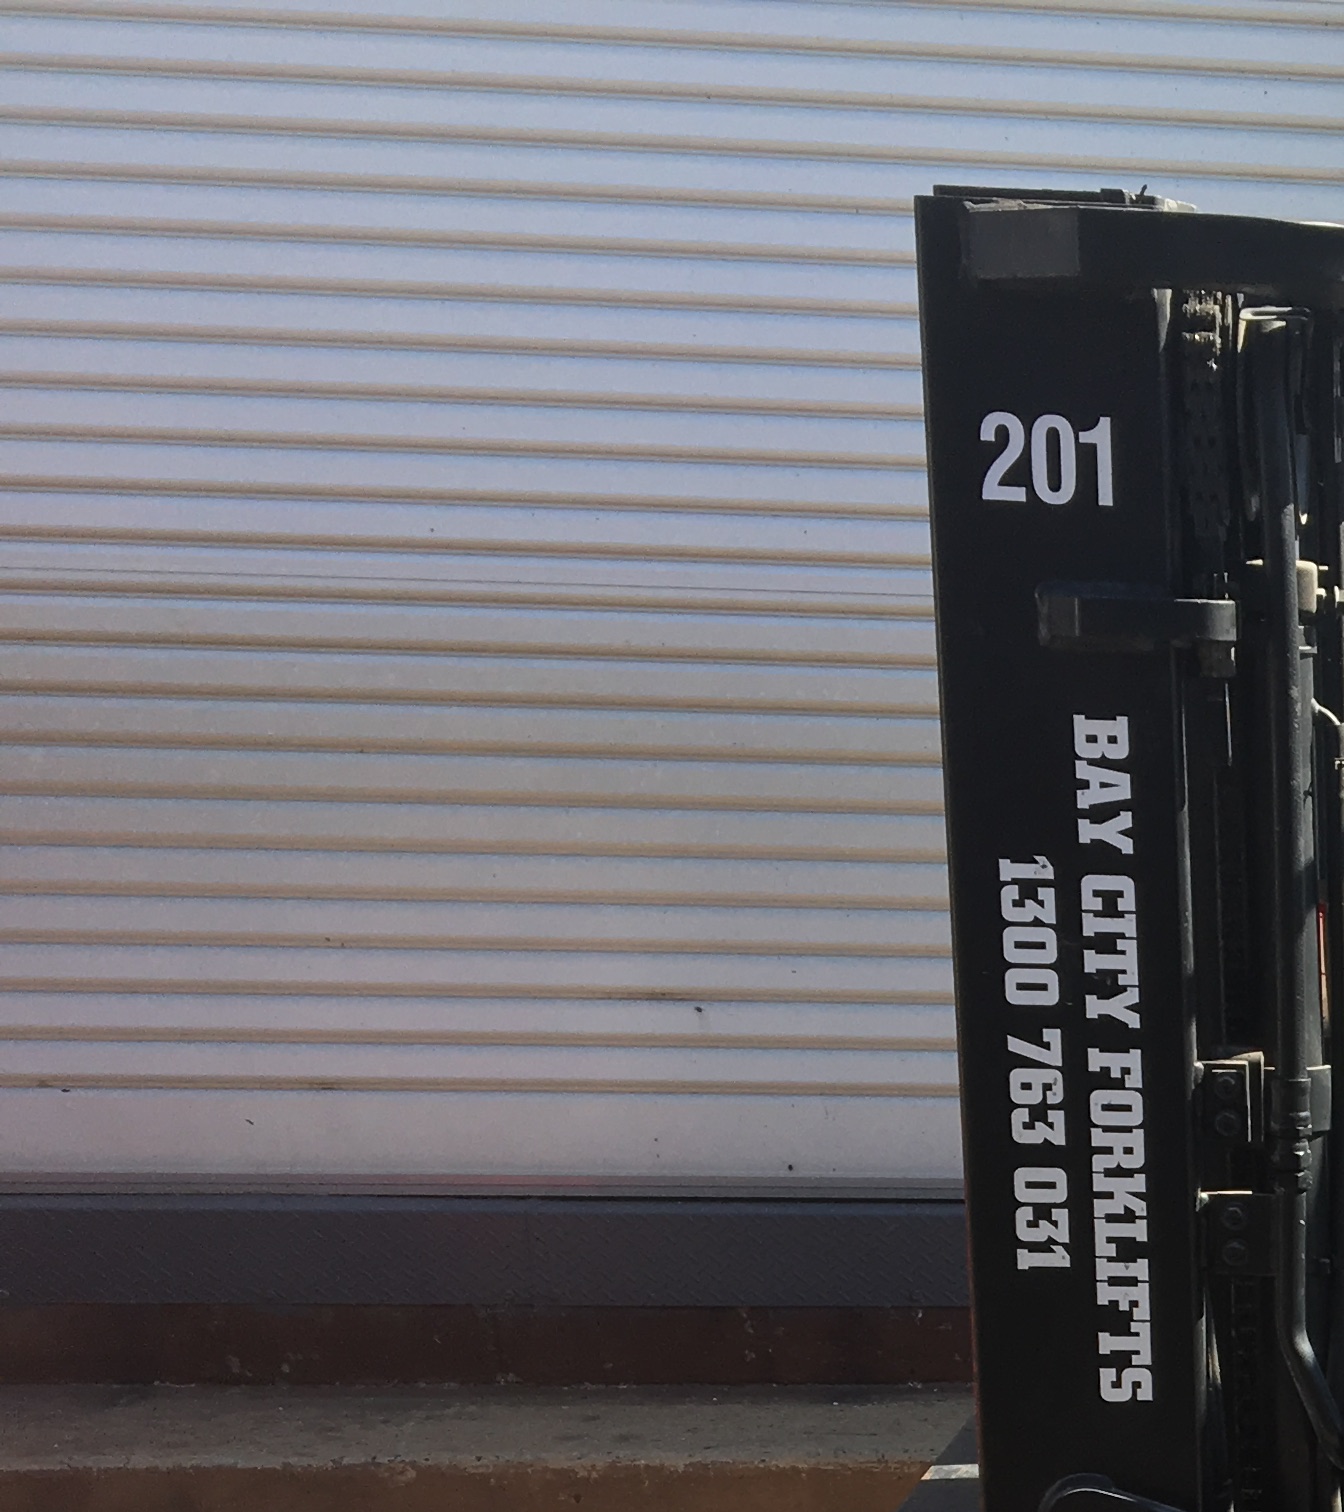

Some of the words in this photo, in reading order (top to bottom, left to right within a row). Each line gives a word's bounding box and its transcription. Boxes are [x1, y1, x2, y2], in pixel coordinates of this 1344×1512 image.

[979, 411, 1114, 507] 201
[1072, 713, 1134, 855] BAY
[998, 855, 1060, 1007] 1300
[1080, 874, 1141, 1029] CITY
[1007, 1028, 1066, 1146] 763
[1013, 1167, 1071, 1271] 031
[1087, 1047, 1154, 1403] FORKLIFTS
